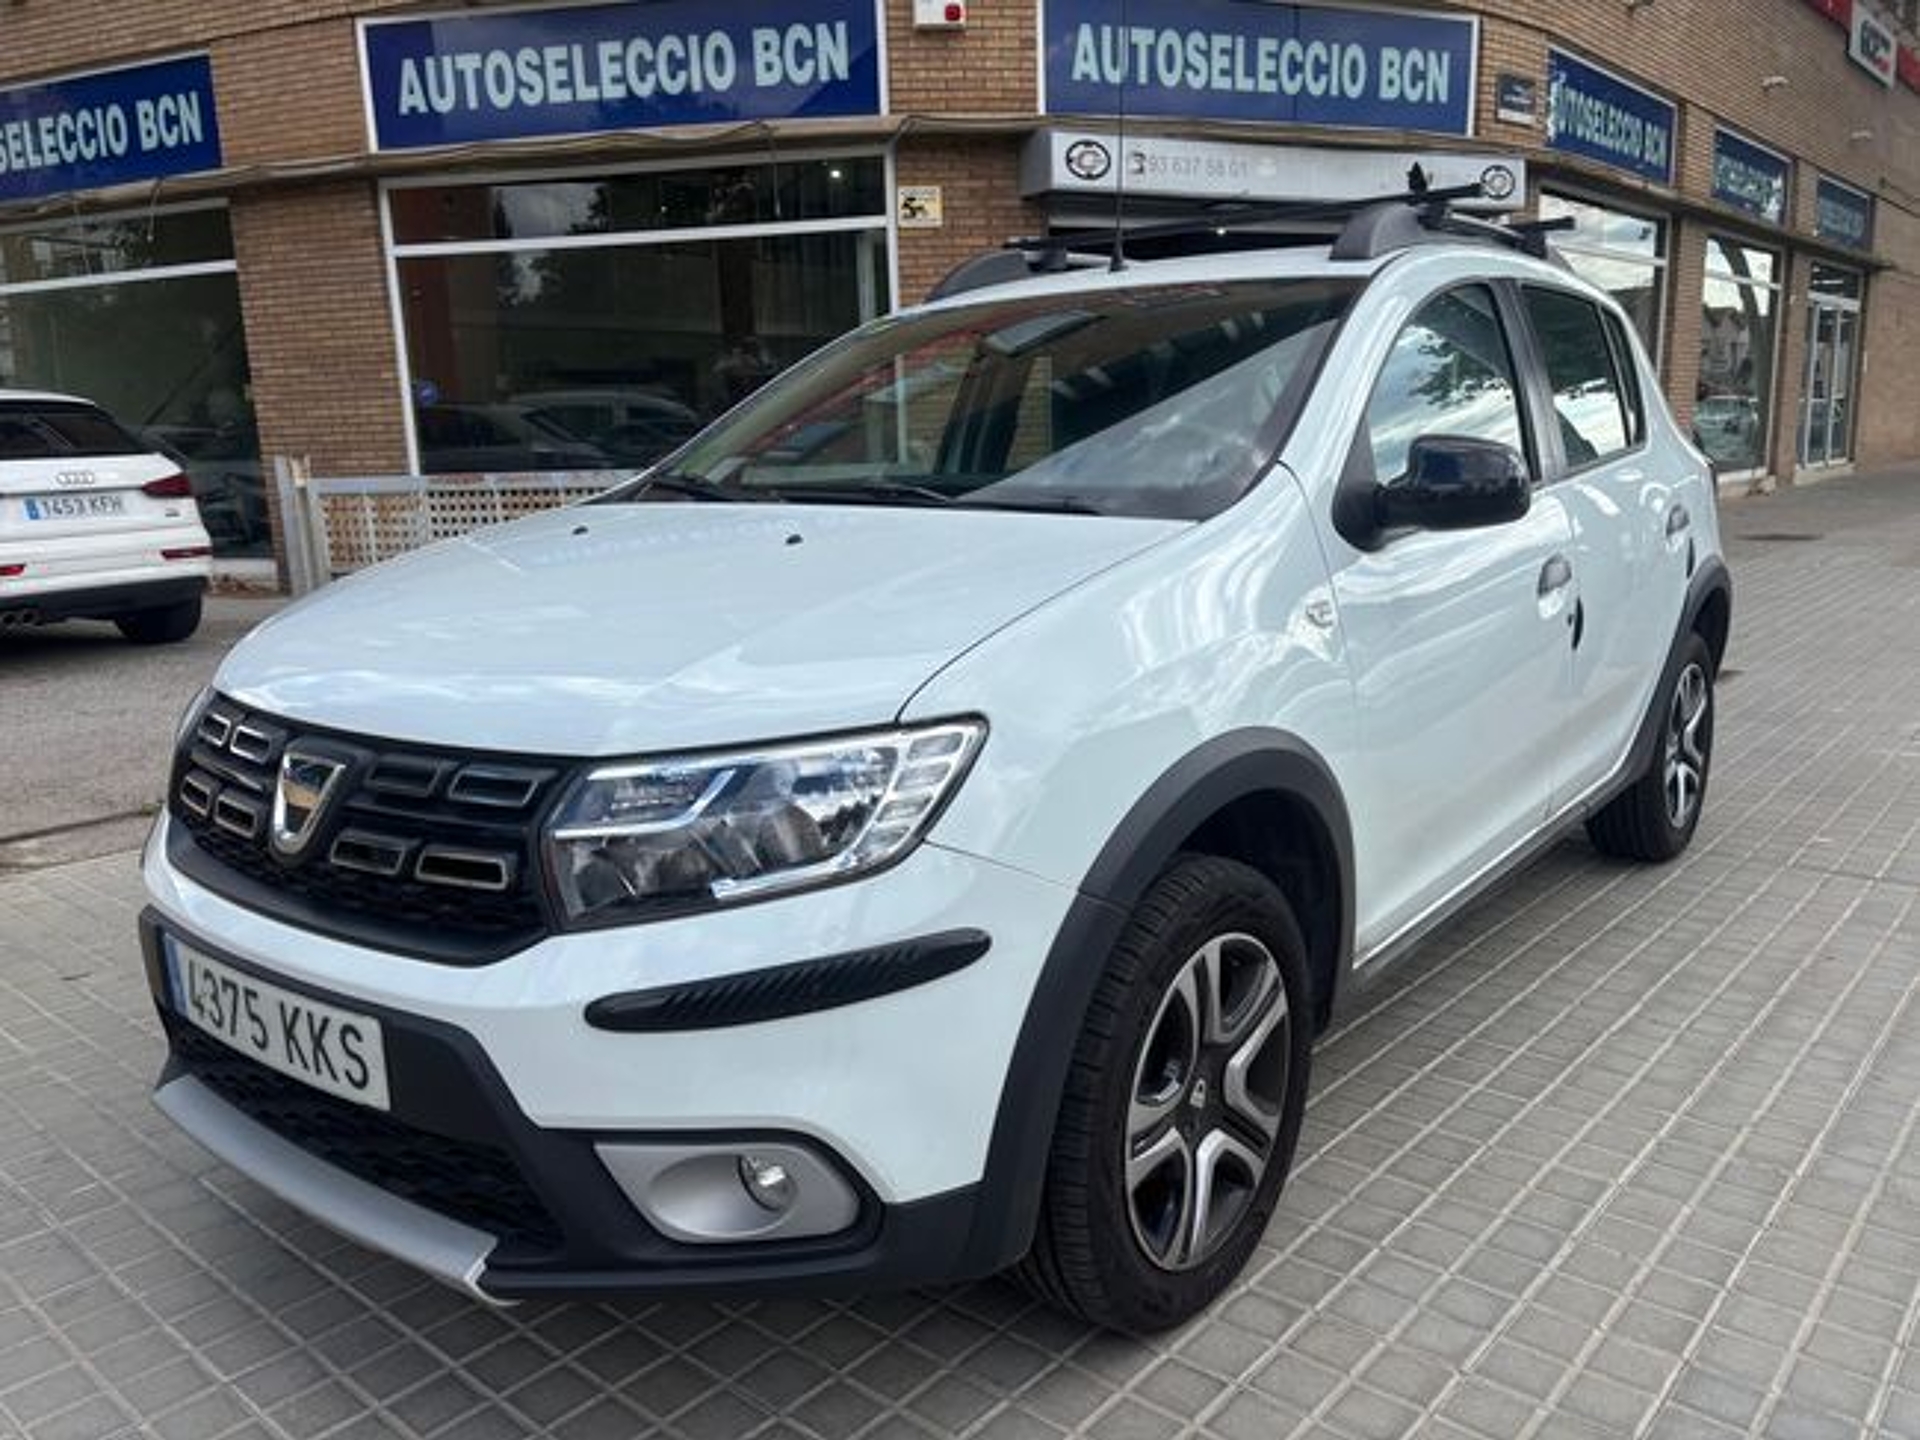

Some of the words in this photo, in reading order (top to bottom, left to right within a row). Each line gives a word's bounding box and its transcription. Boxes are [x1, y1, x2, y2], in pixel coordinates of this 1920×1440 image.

[398, 31, 736, 115] AUTOSELECCIO
[752, 21, 849, 88] BCN
[1071, 23, 1367, 99] AUTOSELECCIO
[1378, 47, 1450, 103] BCN
[136, 90, 204, 152] BCN
[42, 498, 86, 516] 1453
[187, 959, 269, 1051] 4375
[280, 1001, 369, 1090] KKS
